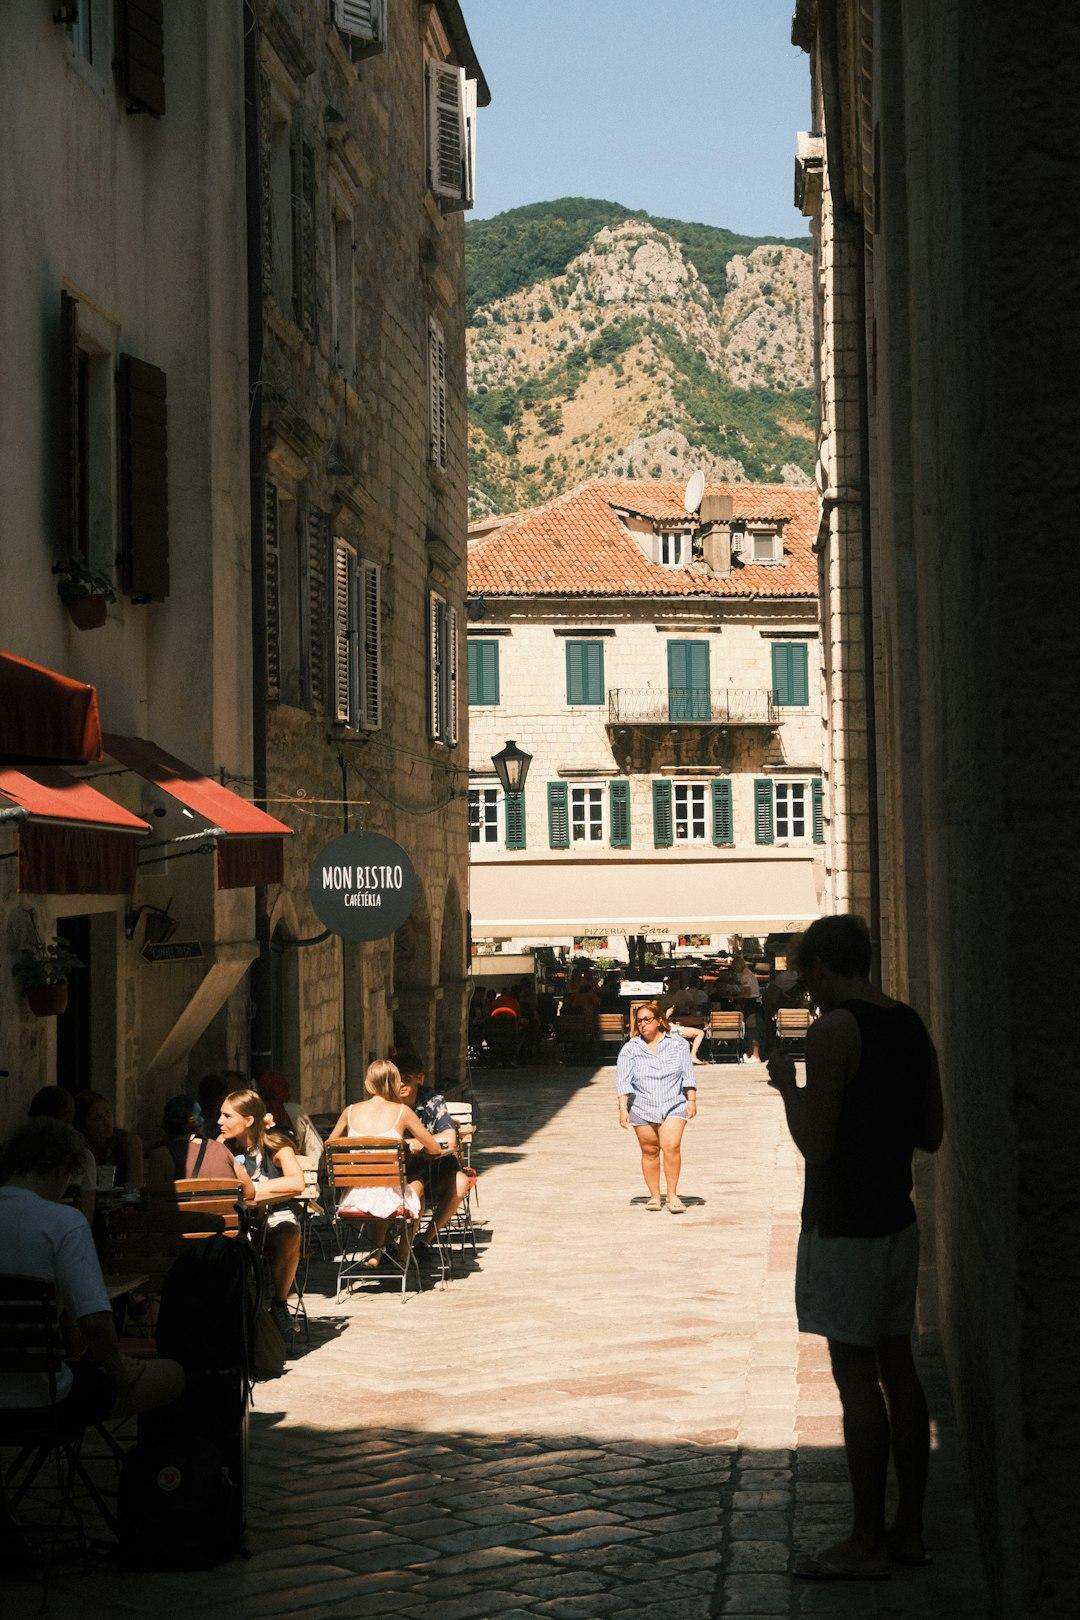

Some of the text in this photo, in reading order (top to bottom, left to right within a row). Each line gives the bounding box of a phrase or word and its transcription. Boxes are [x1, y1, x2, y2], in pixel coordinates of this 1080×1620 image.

[322, 865, 403, 890] MON BISTRO
[344, 891, 382, 907] CAFÉTÉRIA
[584, 924, 669, 936] PIZZERIA Sara
